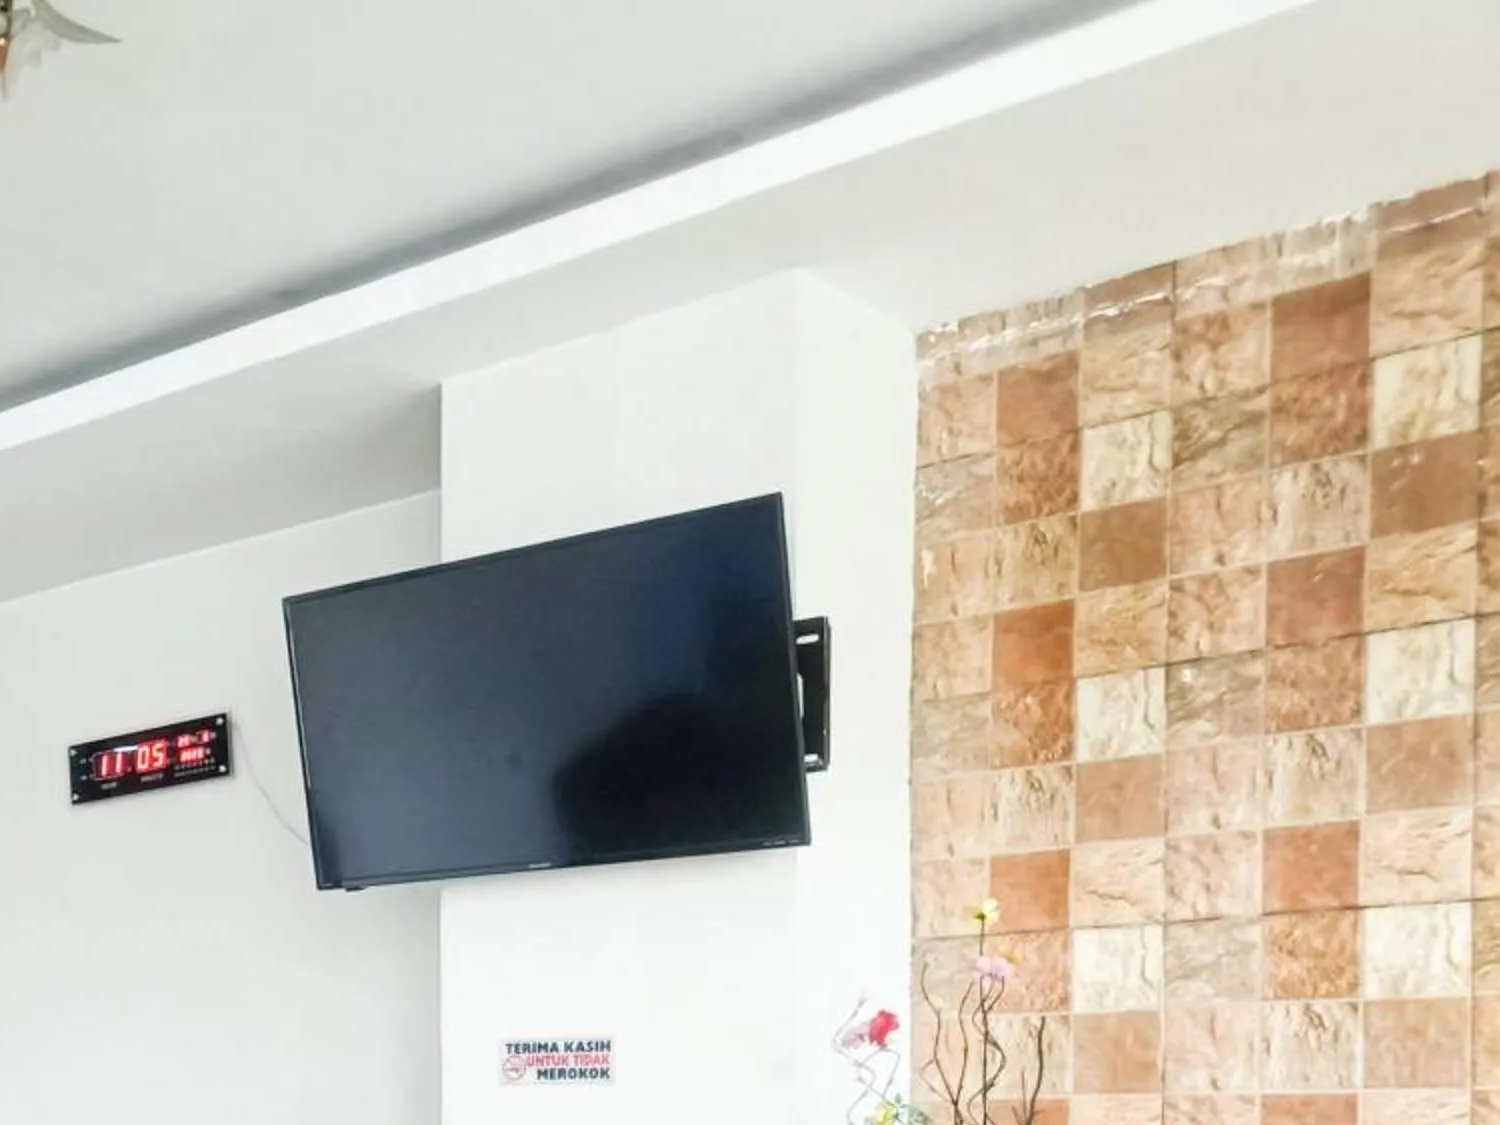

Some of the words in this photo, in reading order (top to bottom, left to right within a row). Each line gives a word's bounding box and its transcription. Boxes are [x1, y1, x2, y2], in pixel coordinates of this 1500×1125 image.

[505, 1042, 559, 1054] TERIMA
[564, 1040, 611, 1053] KASIH
[526, 1055, 569, 1067] UNTUK
[573, 1053, 611, 1066] TIDAK
[537, 1067, 611, 1081] MEROKOK
